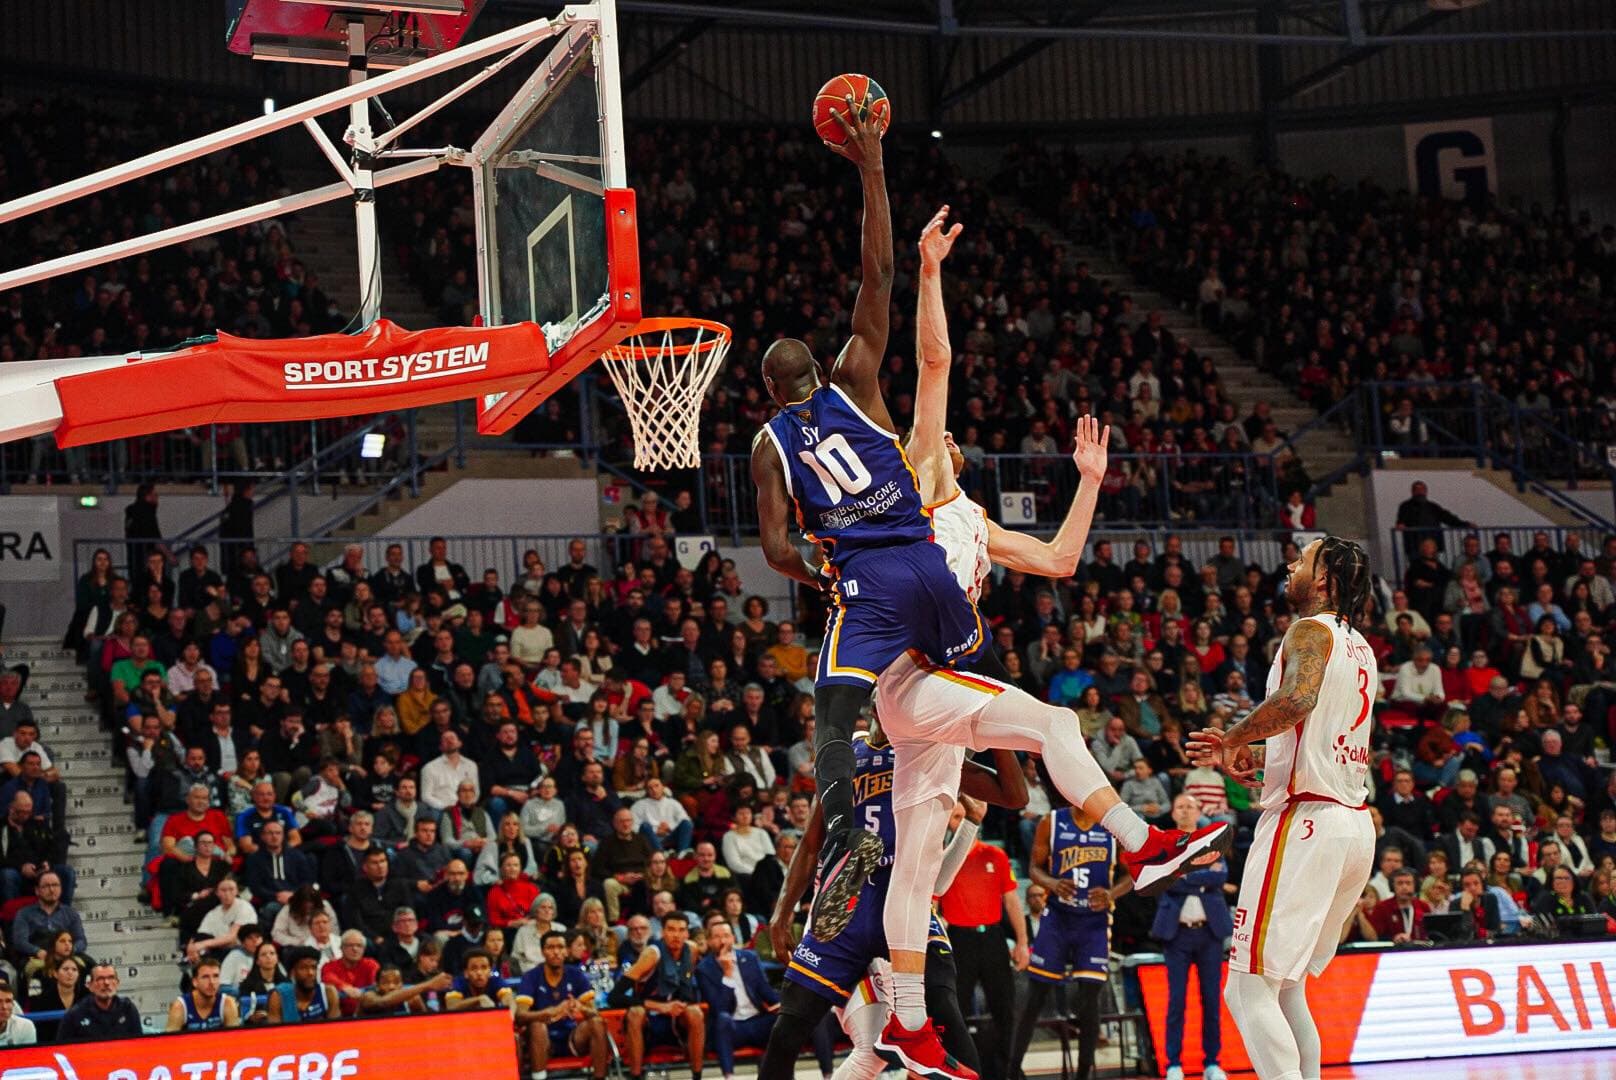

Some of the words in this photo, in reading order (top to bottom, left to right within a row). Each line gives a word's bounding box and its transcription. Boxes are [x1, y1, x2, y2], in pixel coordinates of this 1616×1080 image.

[284, 359, 379, 382] SPORT
[380, 341, 489, 381] SYSTEM
[802, 426, 821, 446] SY
[798, 433, 872, 505] 10
[843, 488, 904, 527] BILLANCOURT
[1021, 496, 1033, 519] 8
[679, 542, 689, 554] G
[843, 579, 859, 597] 10
[1349, 666, 1370, 732] 3
[864, 805, 881, 834] 5
[1300, 819, 1314, 841] 3
[1072, 867, 1090, 889] 15
[113, 921, 122, 932] E
[128, 966, 138, 977] D
[143, 1016, 152, 1026] C
